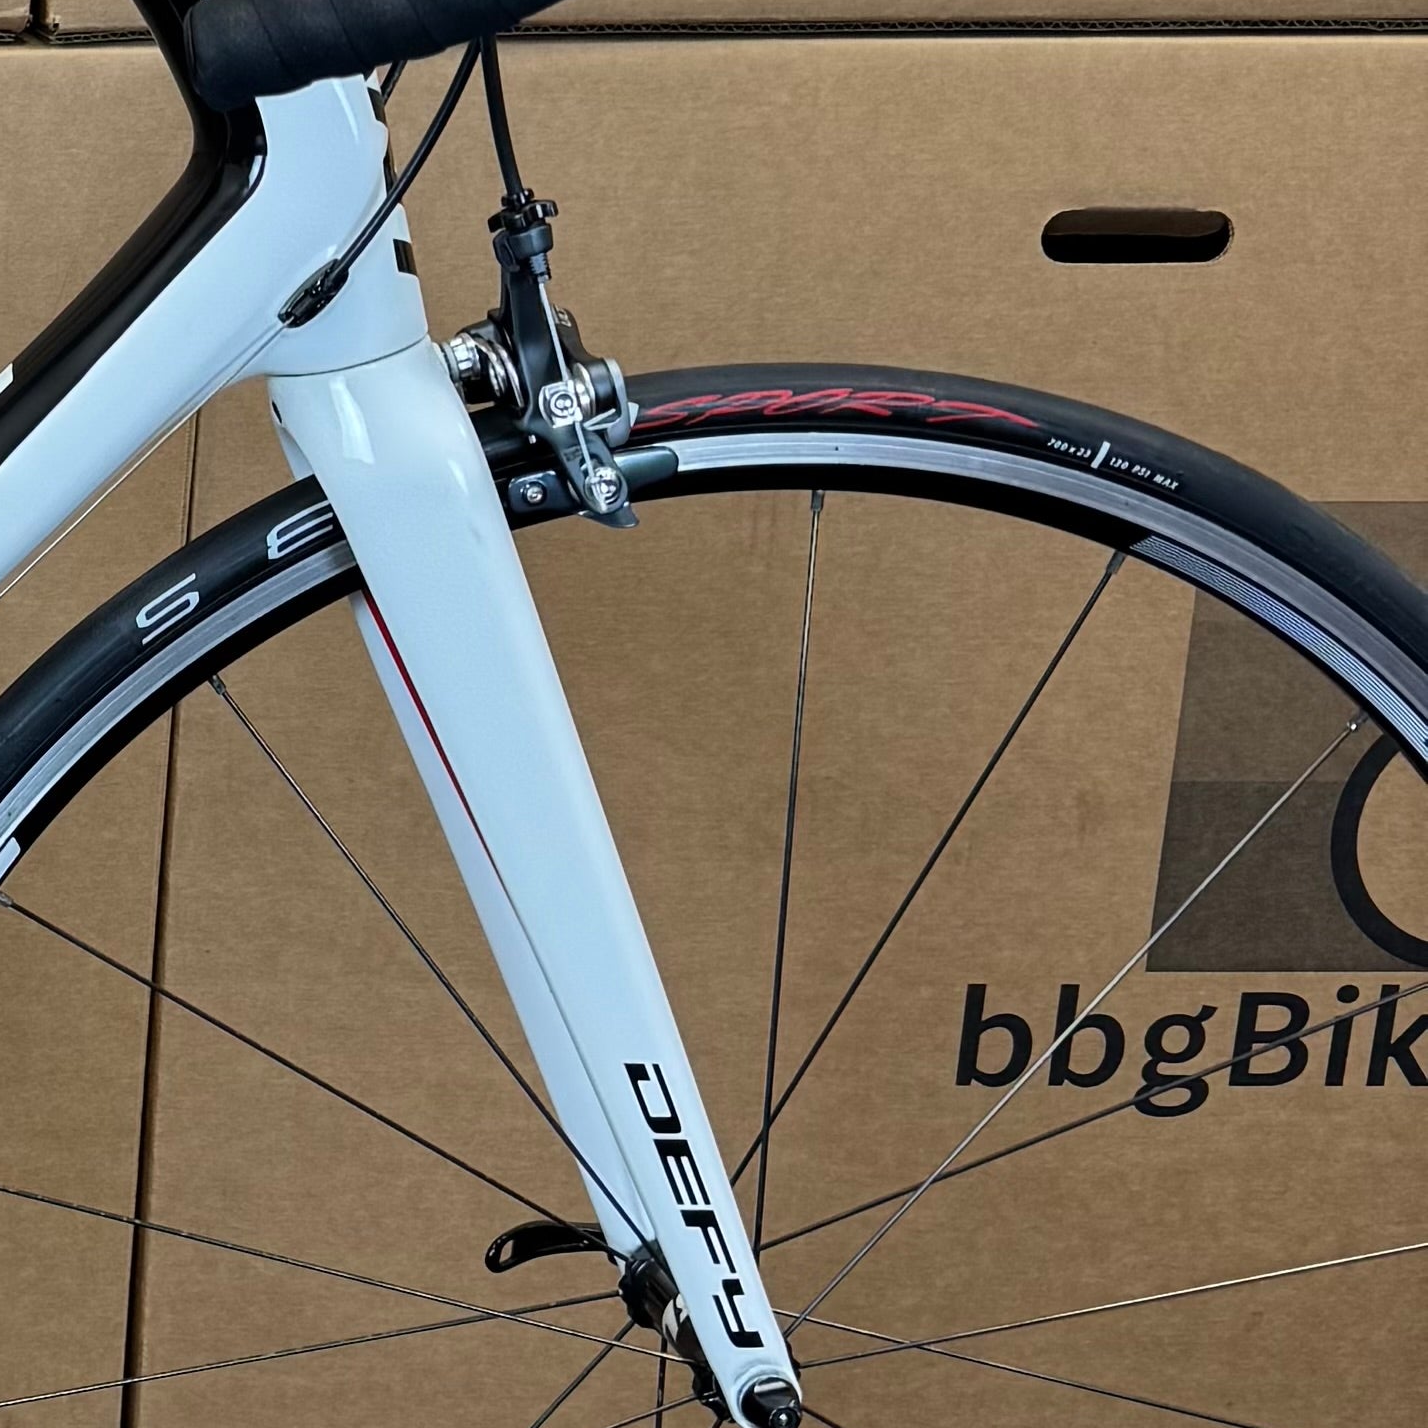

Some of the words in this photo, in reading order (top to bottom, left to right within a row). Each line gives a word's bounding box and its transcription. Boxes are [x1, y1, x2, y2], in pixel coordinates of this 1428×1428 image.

[1130, 463, 1151, 479] PSI
[1152, 473, 1180, 491] MAX
[623, 1062, 765, 1349] DEFY
